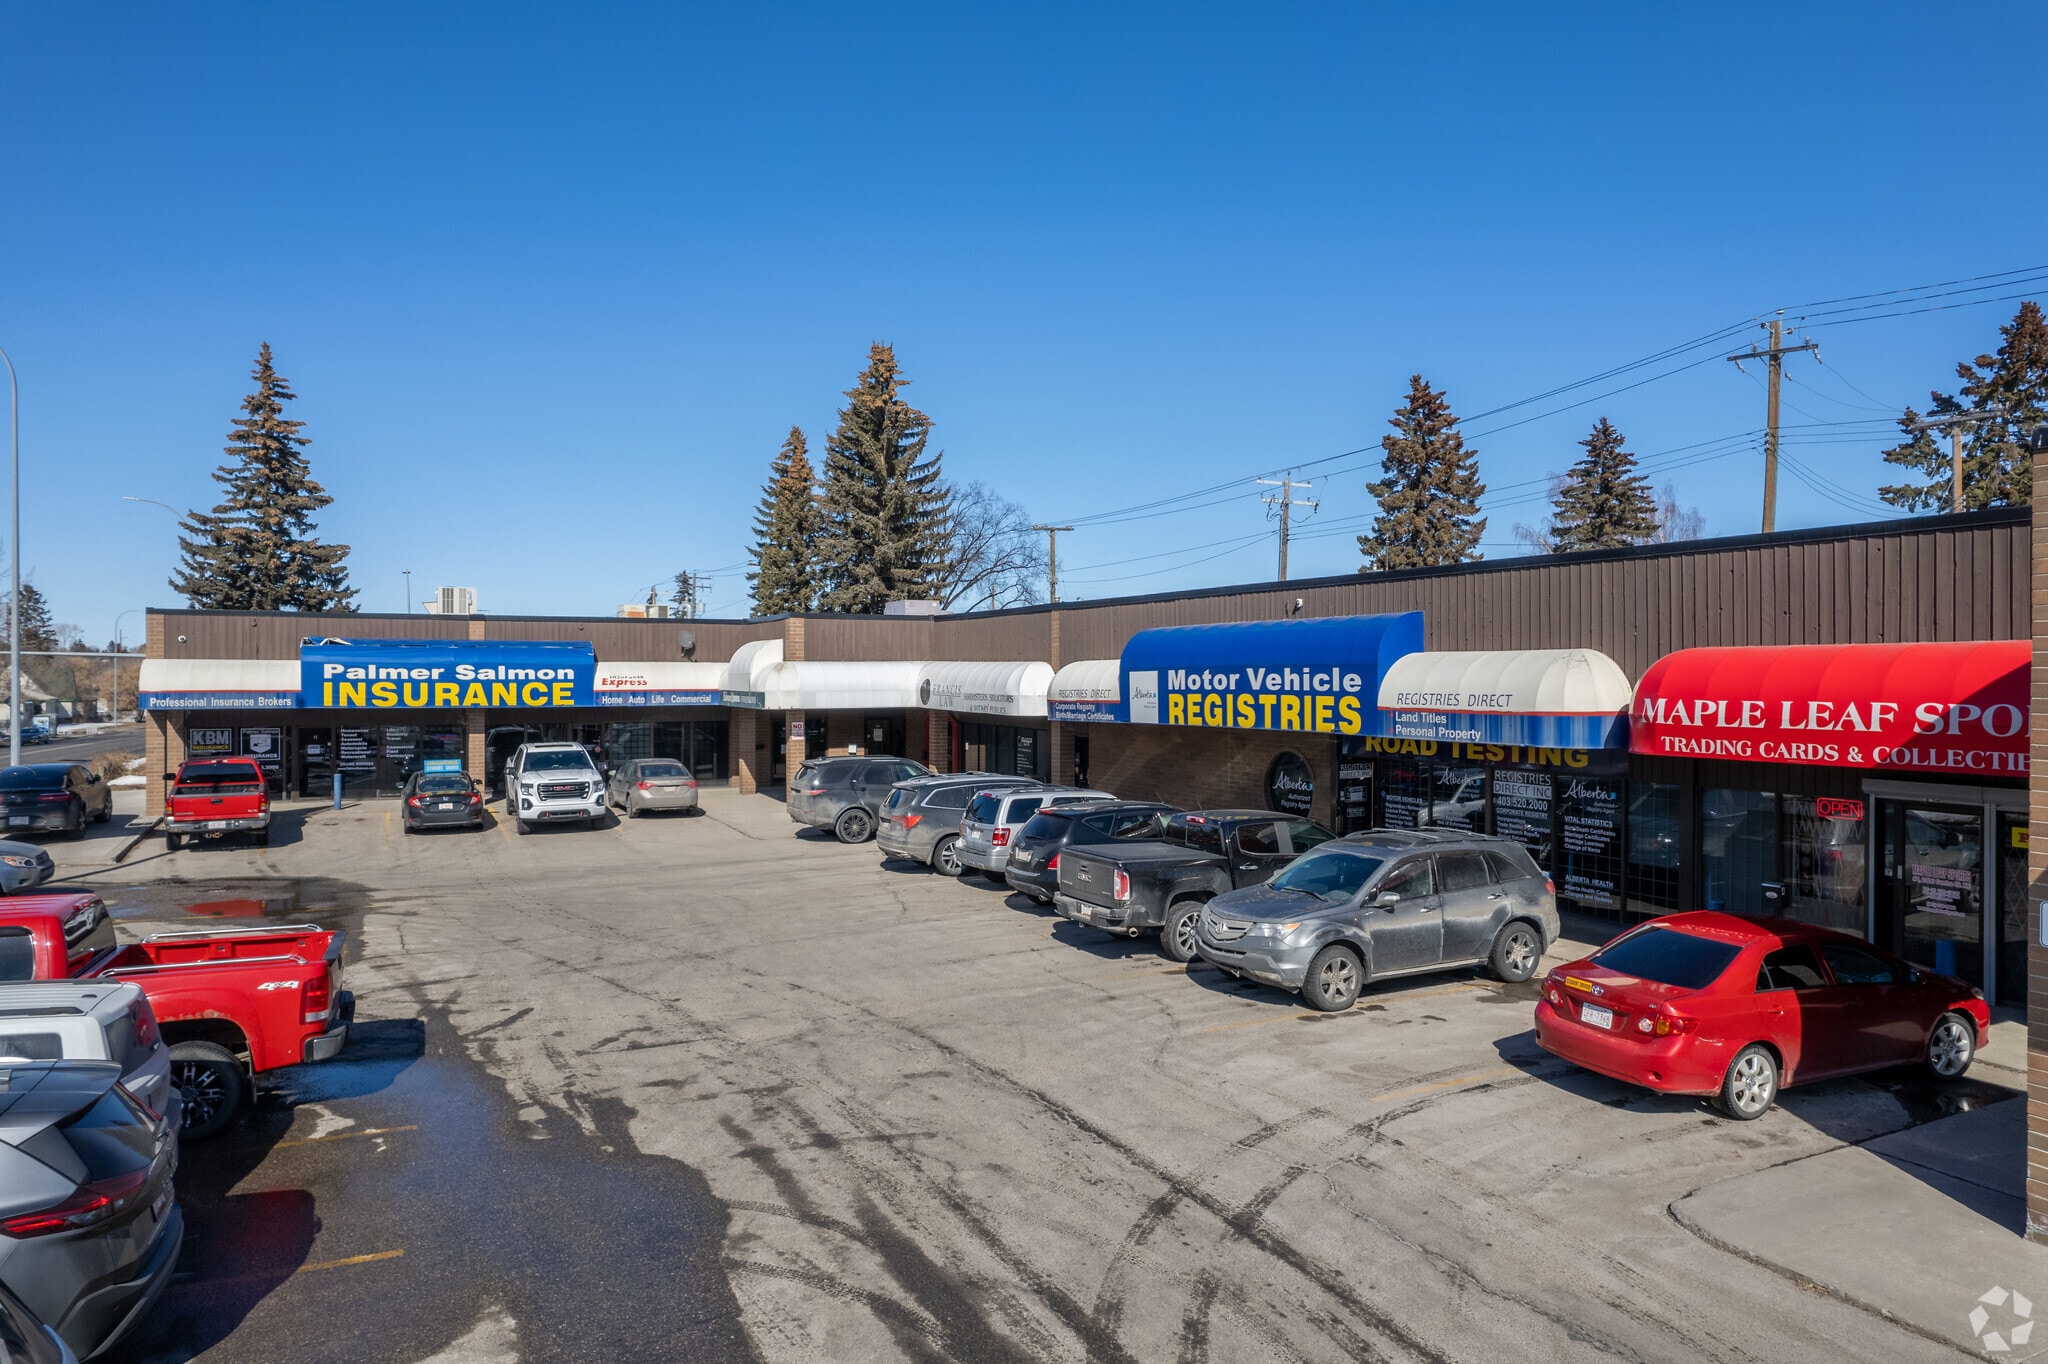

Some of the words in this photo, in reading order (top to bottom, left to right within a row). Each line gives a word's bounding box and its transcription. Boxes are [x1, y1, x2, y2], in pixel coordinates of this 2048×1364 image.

[323, 664, 445, 680] Palmer
[455, 664, 575, 680] Salmon
[601, 678, 648, 688] Express
[1168, 669, 1240, 690] Motor
[1246, 667, 1362, 692] Vehicle
[323, 682, 575, 706] INSURANCE
[932, 684, 962, 695] FRANCIS
[1058, 689, 1088, 698] REGISTRIES
[1090, 689, 1112, 698] DIRECT
[150, 697, 207, 707] Professional
[211, 697, 254, 707] Insurance
[258, 696, 292, 706] Brokers
[602, 695, 622, 704] Home
[628, 695, 645, 704] Auto
[651, 695, 665, 704] Life
[671, 694, 711, 703] Commercial
[939, 695, 954, 707] LAW
[1397, 692, 1460, 707] REGISTRIES
[1467, 693, 1513, 707] DIRECT
[1077, 703, 1095, 711] Registry
[1087, 712, 1115, 721] Certificates
[1168, 693, 1362, 735] REGISTRIES
[1395, 712, 1418, 723] Land
[1420, 712, 1447, 724] Titles
[1640, 697, 1766, 728] MAPLE
[1779, 700, 1899, 732] LEAF
[1912, 702, 2030, 738] SPO
[193, 731, 229, 744] KBM
[1395, 725, 1436, 737] Personal
[1439, 726, 1481, 741] Property
[1366, 737, 1438, 756] ROAD
[1660, 736, 1752, 757] TRADING
[1759, 741, 1839, 762] CARDS
[1847, 745, 1864, 763] &
[1272, 771, 1311, 791] Alberta
[1437, 768, 1476, 786] Alberta
[1494, 770, 1551, 785] REGISTRIES
[1494, 782, 1530, 796] DIRECT
[1533, 786, 1551, 798] INC
[1562, 779, 1613, 800] Alberta
[1288, 793, 1310, 801] Authorized
[1497, 796, 1548, 811] 403.520.2000
[1281, 799, 1298, 809] Registry
[1298, 802, 1310, 810] Agent
[1819, 800, 1861, 818] OPEN
[1496, 807, 1524, 816] CORPORATE
[1525, 810, 1548, 819] REGISTRY
[1564, 815, 1580, 824] VITAL
[1581, 817, 1613, 828] STATISTICS
[1564, 831, 1584, 839] Marriage
[1584, 834, 1610, 842] Certificates
[1590, 828, 1616, 837] Certificates
[1564, 837, 1584, 845] Marriage
[1564, 843, 1581, 851] Change
[1588, 846, 1601, 854] Name
[1565, 874, 1590, 885] ALBERTA
[1591, 878, 1613, 889] HEALTH
[1564, 884, 1580, 892] Alberta
[1581, 886, 1595, 894] Health
[1564, 890, 1584, 899] Changes
[1594, 895, 1613, 904] Updates
